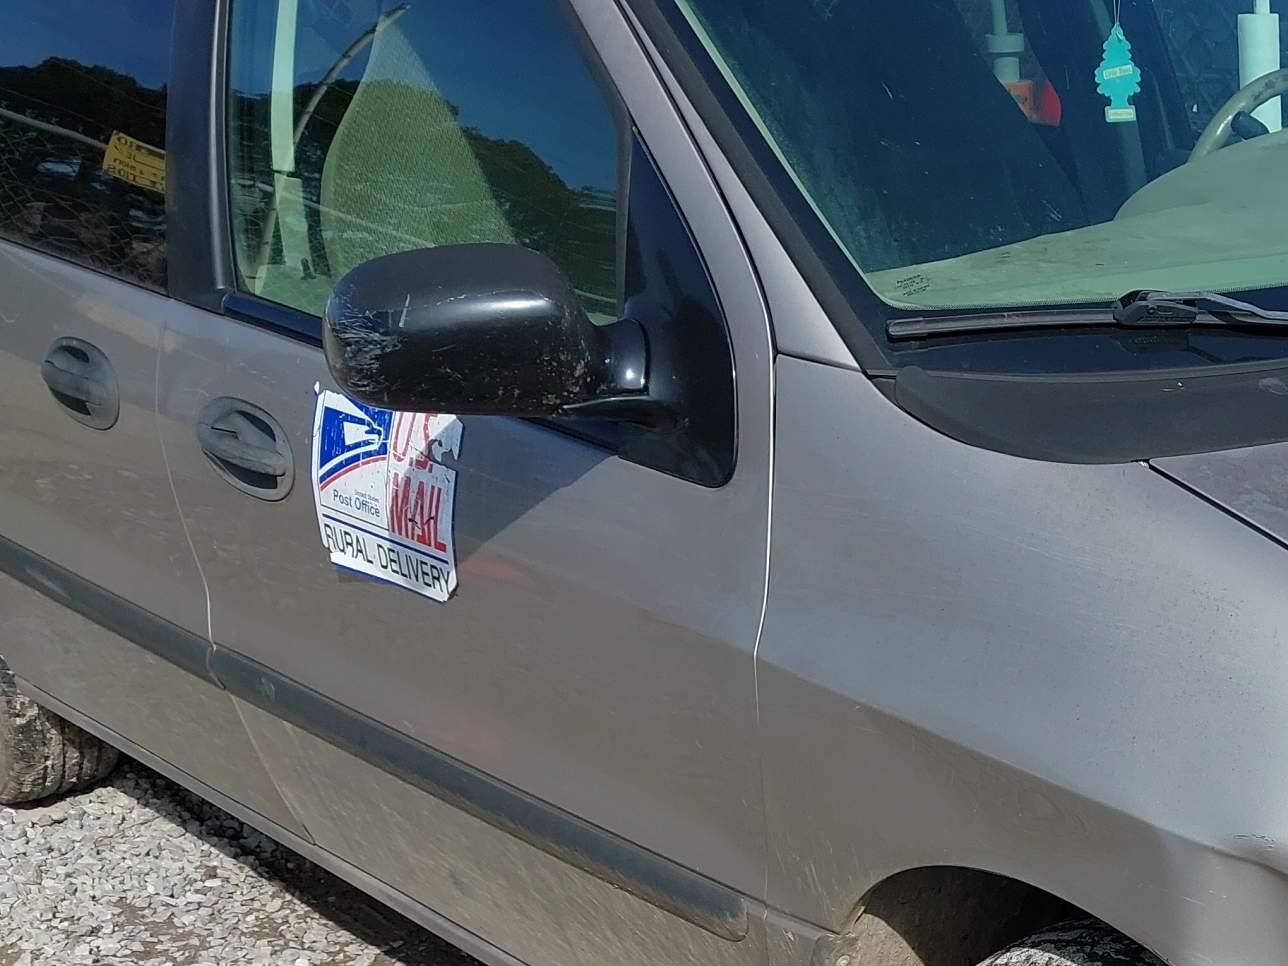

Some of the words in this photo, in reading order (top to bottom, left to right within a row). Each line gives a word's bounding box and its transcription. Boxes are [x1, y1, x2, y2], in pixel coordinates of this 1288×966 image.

[332, 489, 352, 507] Post
[354, 499, 380, 518] Office
[323, 522, 374, 565] RURAL
[376, 542, 450, 595] DELIVERY
